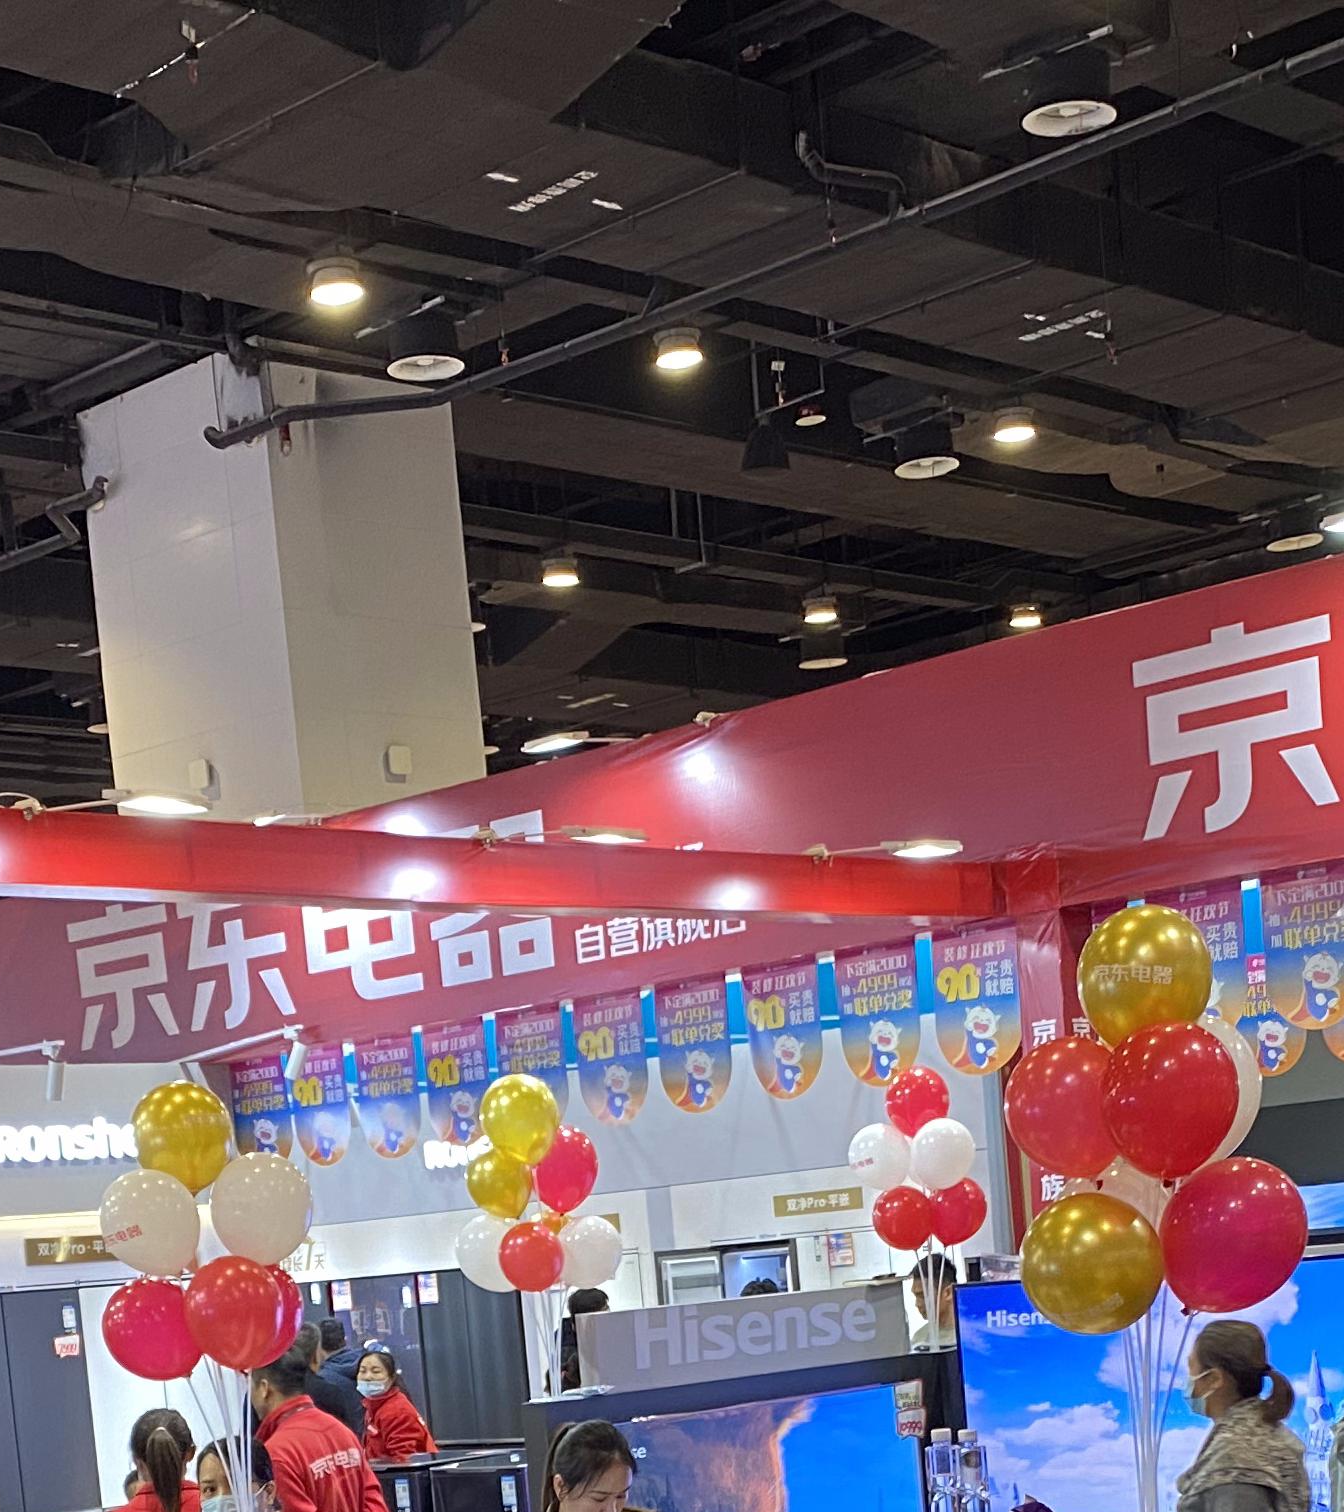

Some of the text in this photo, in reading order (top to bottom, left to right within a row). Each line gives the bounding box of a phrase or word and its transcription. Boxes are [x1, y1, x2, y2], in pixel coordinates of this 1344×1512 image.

[1182, 901, 1230, 923] 狂欢节
[1206, 920, 1239, 942] 买贵
[984, 959, 1013, 980] 买贵
[1095, 963, 1174, 985] 京东电器
[985, 978, 1014, 998] 就赔
[985, 1308, 1054, 1330] Hisen
[633, 1298, 877, 1371] Hisense
